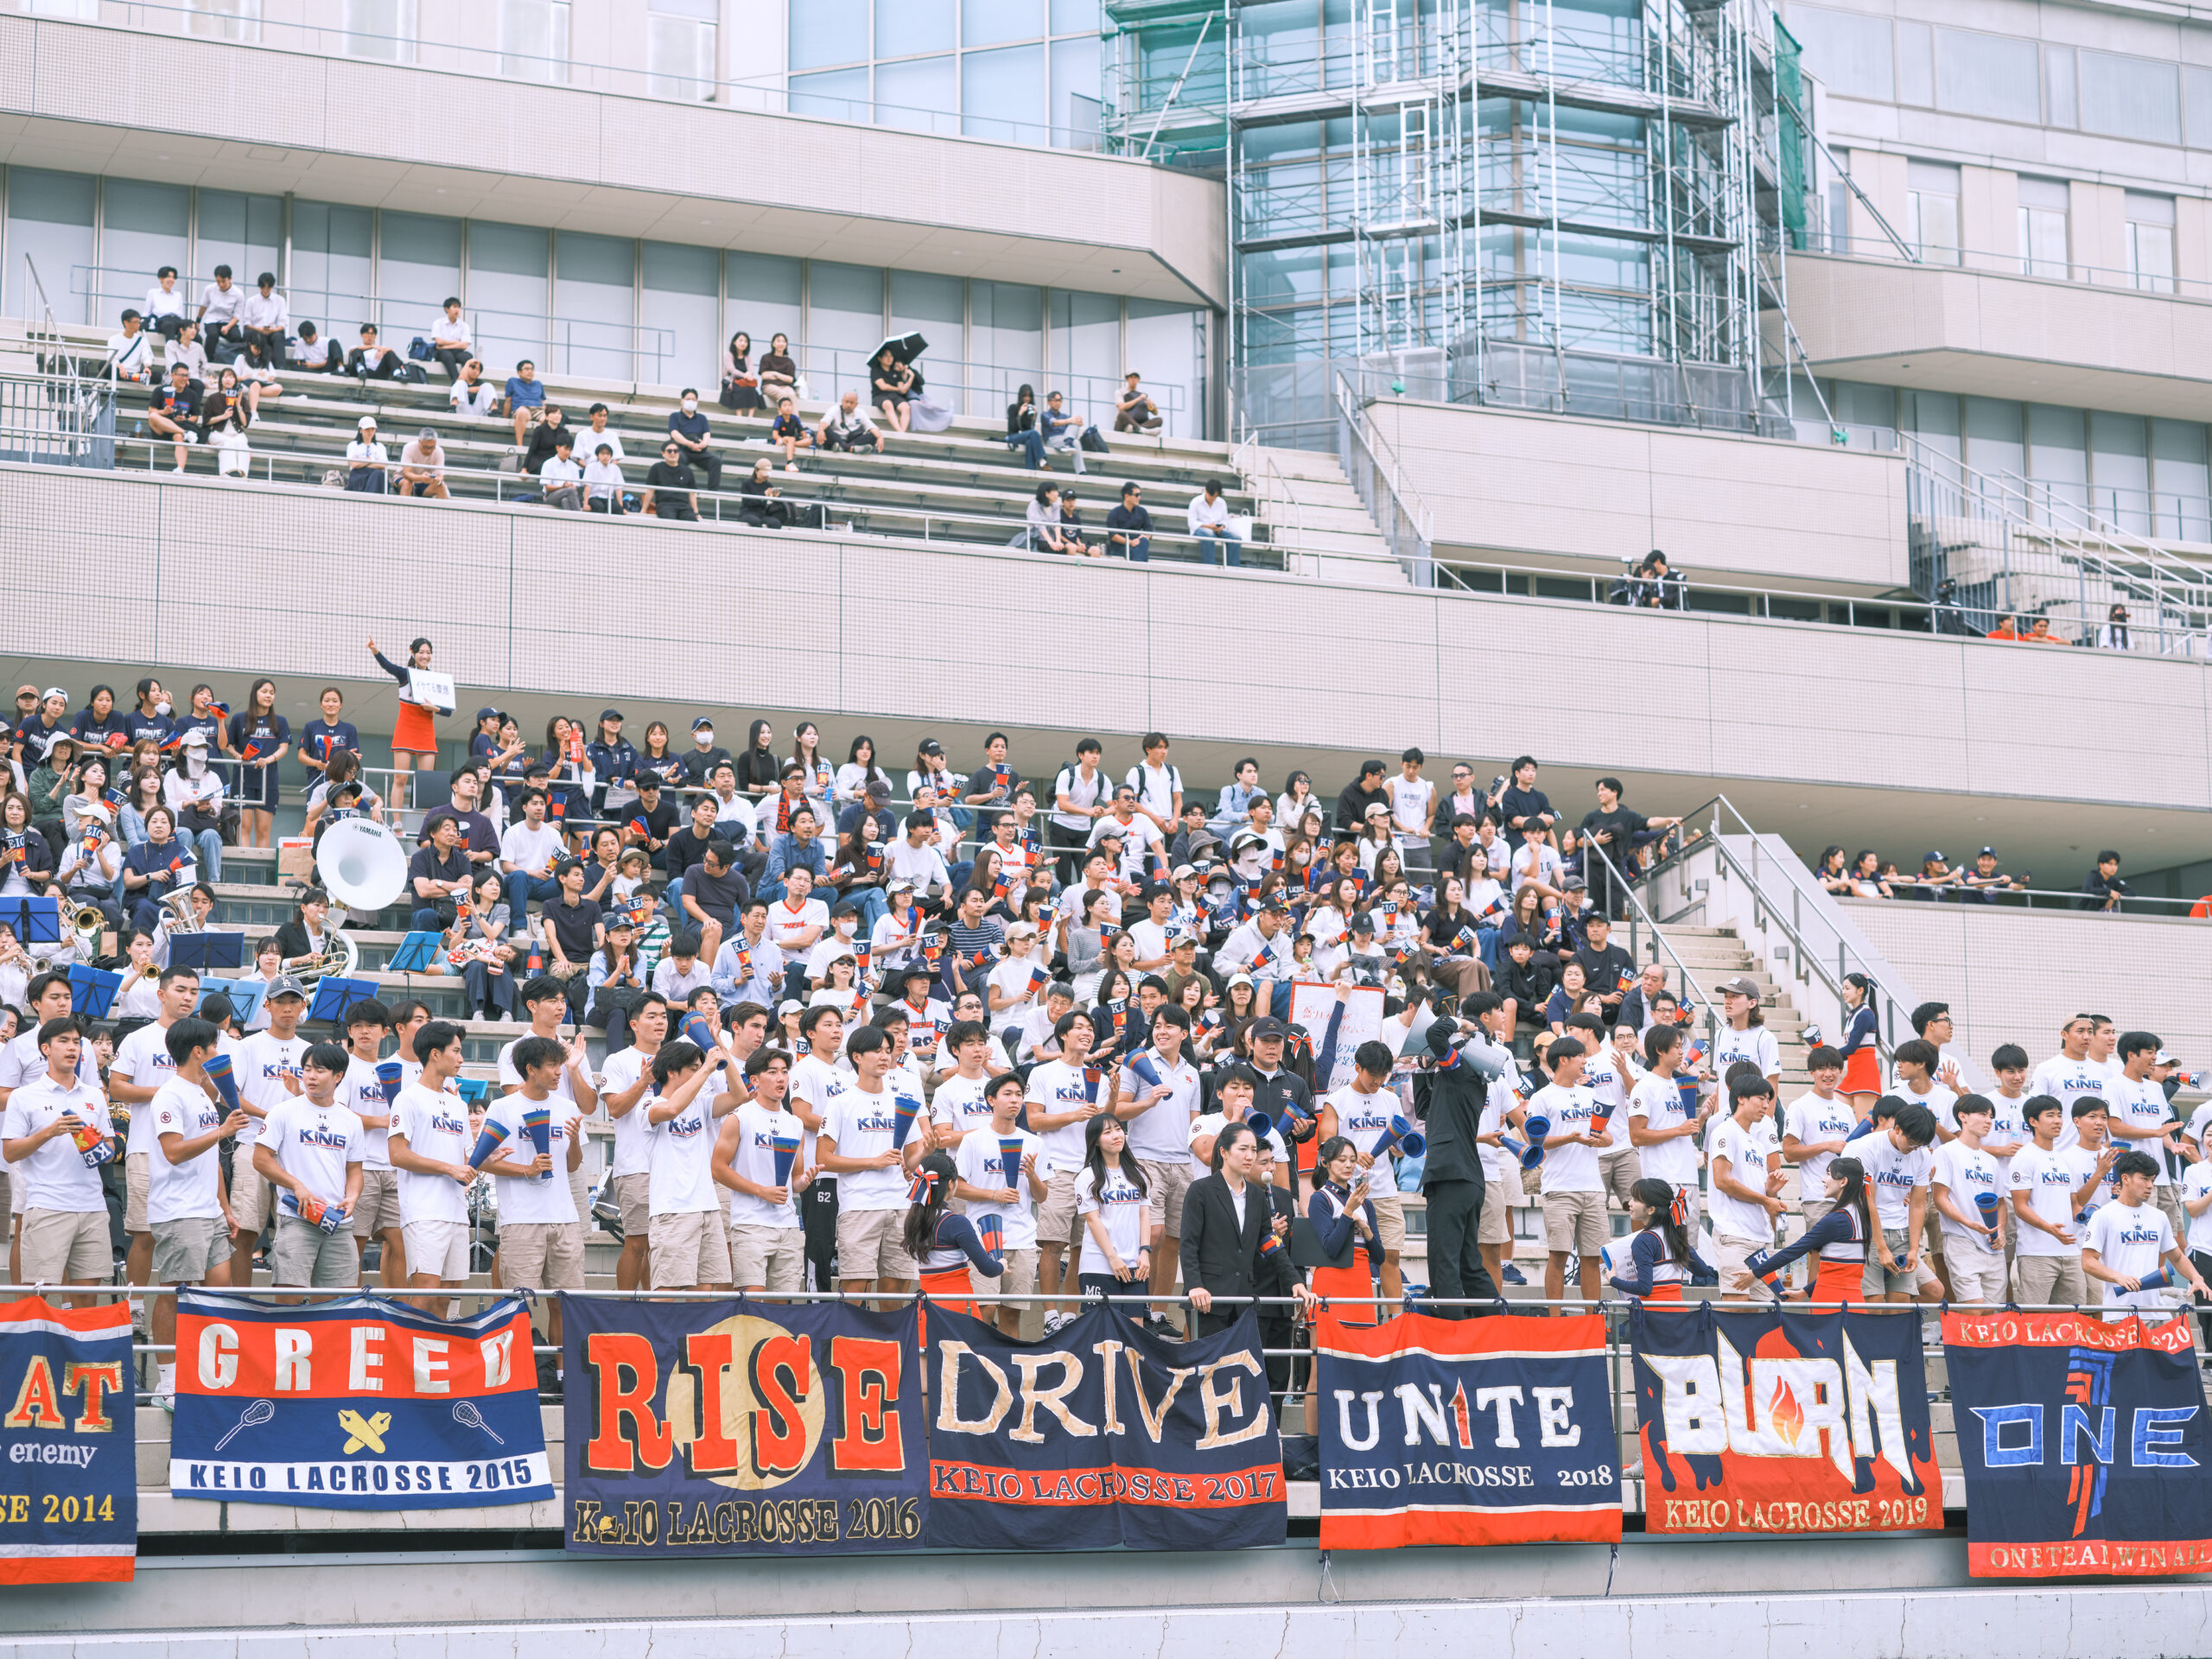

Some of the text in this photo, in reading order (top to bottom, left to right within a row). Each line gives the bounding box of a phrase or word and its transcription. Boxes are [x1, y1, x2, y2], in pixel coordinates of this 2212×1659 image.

[359, 825, 382, 839] YAMAHA
[283, 977, 292, 988] LA
[1056, 1088, 1087, 1101] KIN
[2063, 1078, 2102, 1092] KING
[2132, 1103, 2160, 1116] KING
[432, 1116, 463, 1135] KING
[668, 1116, 702, 1135] KING
[1349, 1116, 1387, 1130] KING
[1819, 1120, 1850, 1135] KING
[300, 1128, 346, 1149] KING
[1878, 1170, 1914, 1186] KING
[1965, 1168, 1994, 1185] KING
[2042, 1172, 2070, 1185] KING
[817, 1191, 831, 1203] 62
[1103, 1188, 1141, 1205] KING
[2120, 1230, 2158, 1244] KING
[1085, 1284, 1101, 1296] MG
[1960, 1319, 2018, 1344] KEIO
[197, 1323, 514, 1394] GREED
[587, 1332, 906, 1473] RISE
[936, 1339, 1270, 1451] DRIVE
[1333, 1376, 1581, 1452] UNITE
[1638, 1325, 1916, 1491] BURN
[1968, 1403, 2201, 1468] ONE
[9, 1441, 98, 1469] enemy
[190, 1459, 533, 1492] KEIO LACROSSE 2015
[932, 1465, 1279, 1503] KEIO LACROSSE 2017
[1326, 1462, 1614, 1491] KEIO LACROSSE 2018
[43, 1494, 116, 1523] 2014
[1664, 1496, 1929, 1530] KEIO LACROSSE 2019
[666, 1498, 841, 1546] LACROSSE
[846, 1497, 922, 1541] 2016
